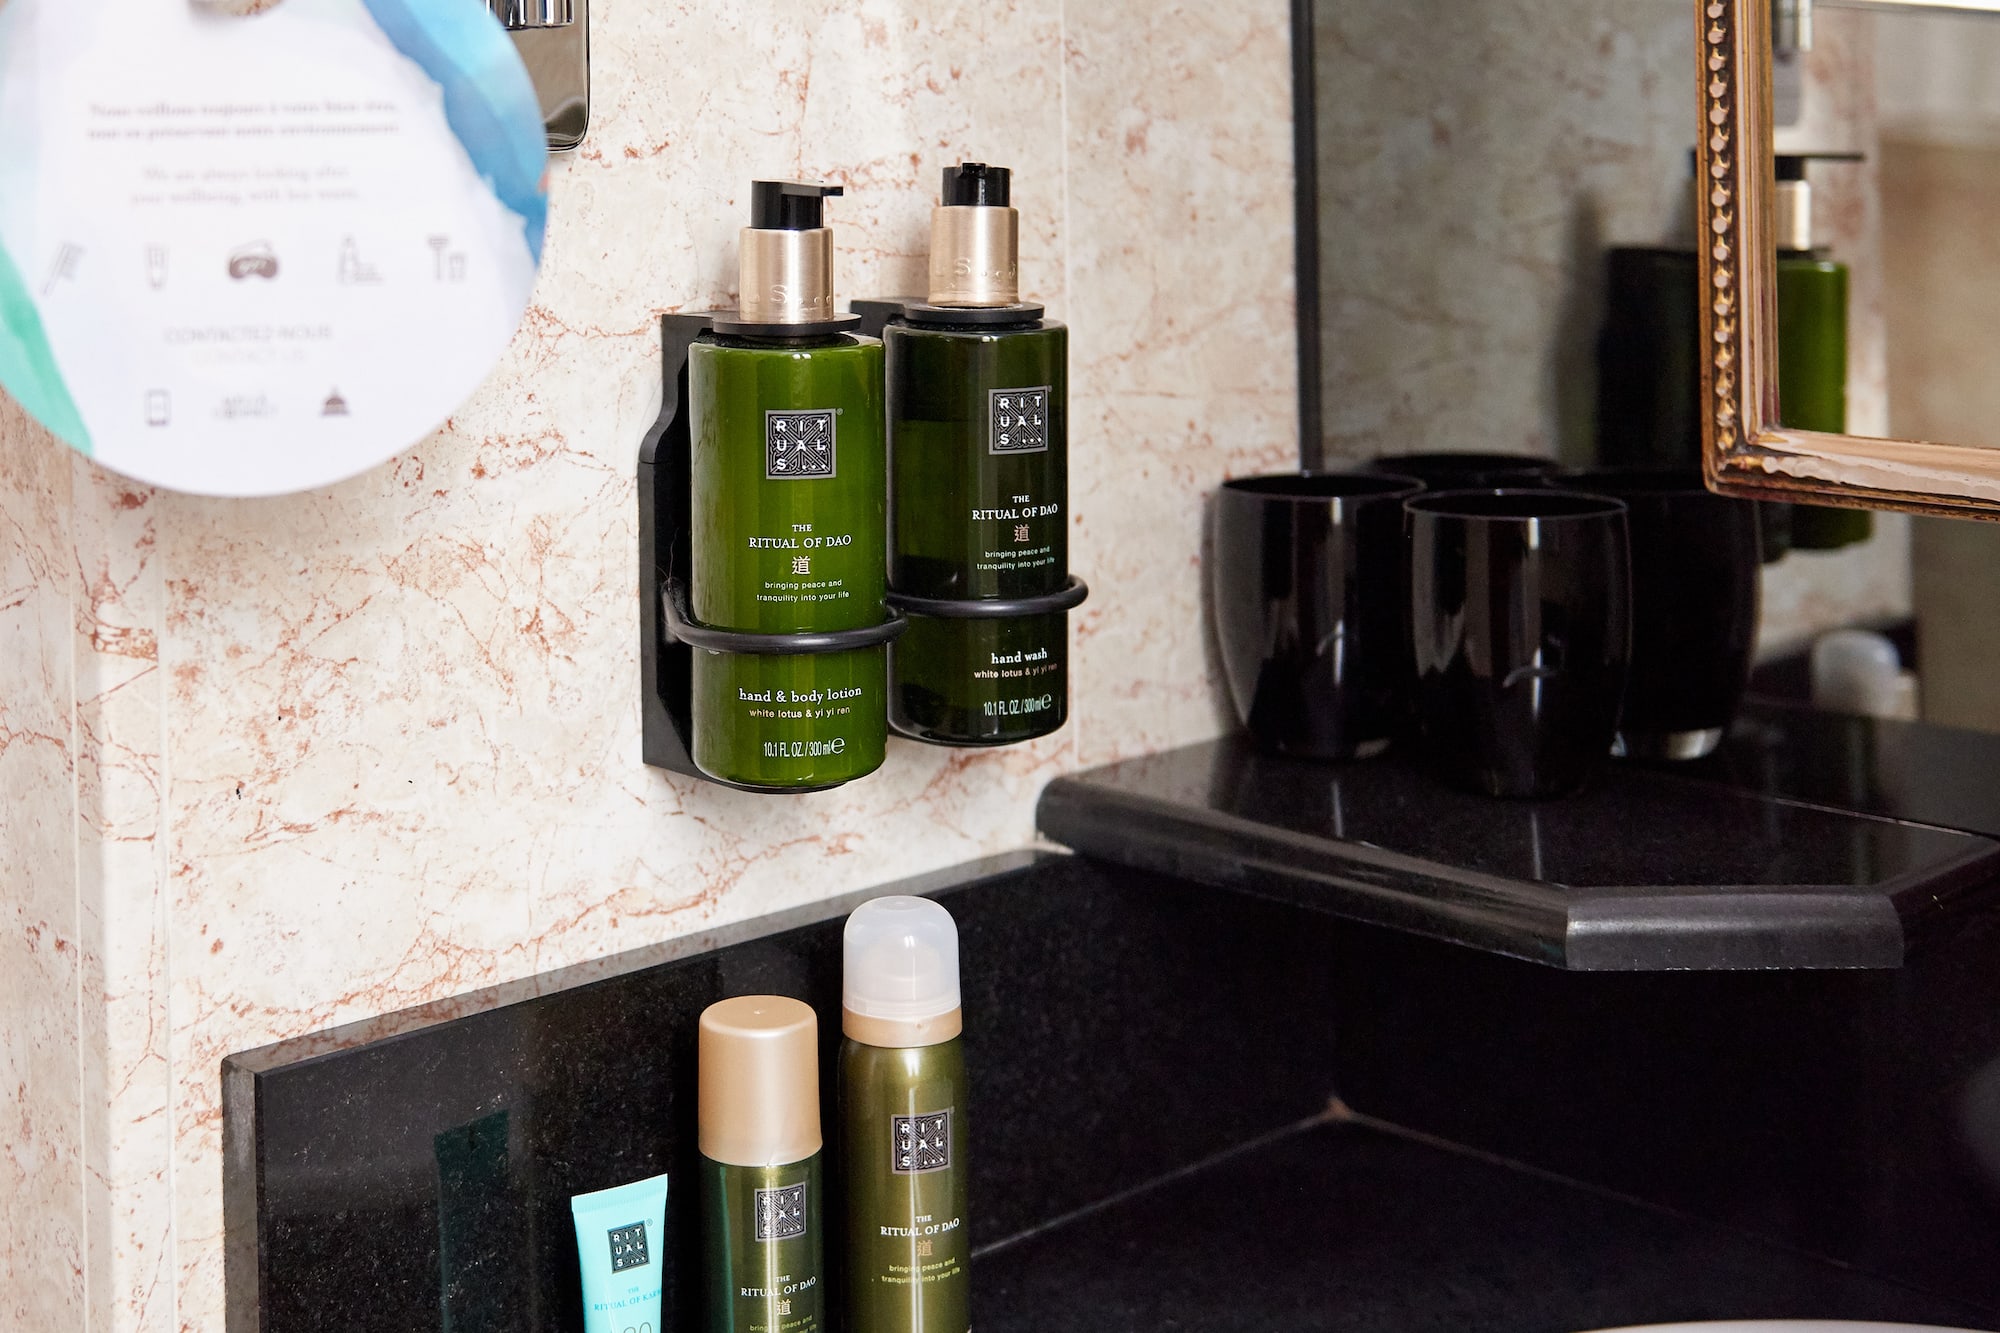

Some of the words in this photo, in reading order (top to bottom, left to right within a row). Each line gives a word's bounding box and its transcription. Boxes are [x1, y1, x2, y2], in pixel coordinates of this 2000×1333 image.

[1012, 495, 1030, 503] THE
[972, 508, 1019, 520] RITUAL
[1022, 507, 1038, 518] OF
[1040, 503, 1058, 516] DAO
[792, 524, 812, 532] THE
[1014, 523, 1030, 542] 道
[748, 537, 800, 549] RITUAL
[803, 537, 823, 549] OF
[826, 534, 852, 547] DAO
[985, 550, 1016, 559] bringing
[1018, 548, 1038, 557] peace
[1040, 545, 1050, 554] and
[791, 555, 811, 575] 道
[976, 562, 1015, 571] tranquility
[1032, 559, 1046, 568] your
[765, 581, 799, 590] bringing
[801, 581, 826, 590] peace
[828, 579, 842, 587] and
[756, 594, 798, 603] tranquility
[819, 592, 837, 602] your
[838, 591, 850, 599] life
[991, 651, 1022, 664] hand
[1025, 647, 1048, 661] wash
[974, 670, 999, 679] white
[1001, 669, 1023, 678] lotus
[1025, 667, 1031, 676] &
[1033, 666, 1039, 677] yi
[1041, 665, 1047, 675] yi
[739, 688, 771, 702] hand
[776, 690, 787, 702] &
[791, 689, 823, 705] body
[827, 687, 862, 700] lotion
[749, 708, 775, 718] white
[778, 709, 802, 718] lotus
[805, 709, 812, 718] &
[815, 708, 824, 719] yi
[826, 707, 834, 718] yi
[837, 706, 850, 714] ren
[984, 701, 997, 716] 10.1
[764, 741, 778, 757] 10.1
[915, 1215, 932, 1223] THE
[880, 1226, 922, 1237] RITUAL
[925, 1224, 940, 1235] OF
[942, 1217, 960, 1232] DAO
[922, 1262, 943, 1272] peace
[944, 1257, 956, 1267] and
[775, 1275, 791, 1283] THE
[937, 1271, 951, 1280] your
[741, 1287, 781, 1297] RITUAL
[783, 1283, 797, 1295] OF
[799, 1276, 816, 1290] DAO
[777, 1299, 791, 1316] 道
